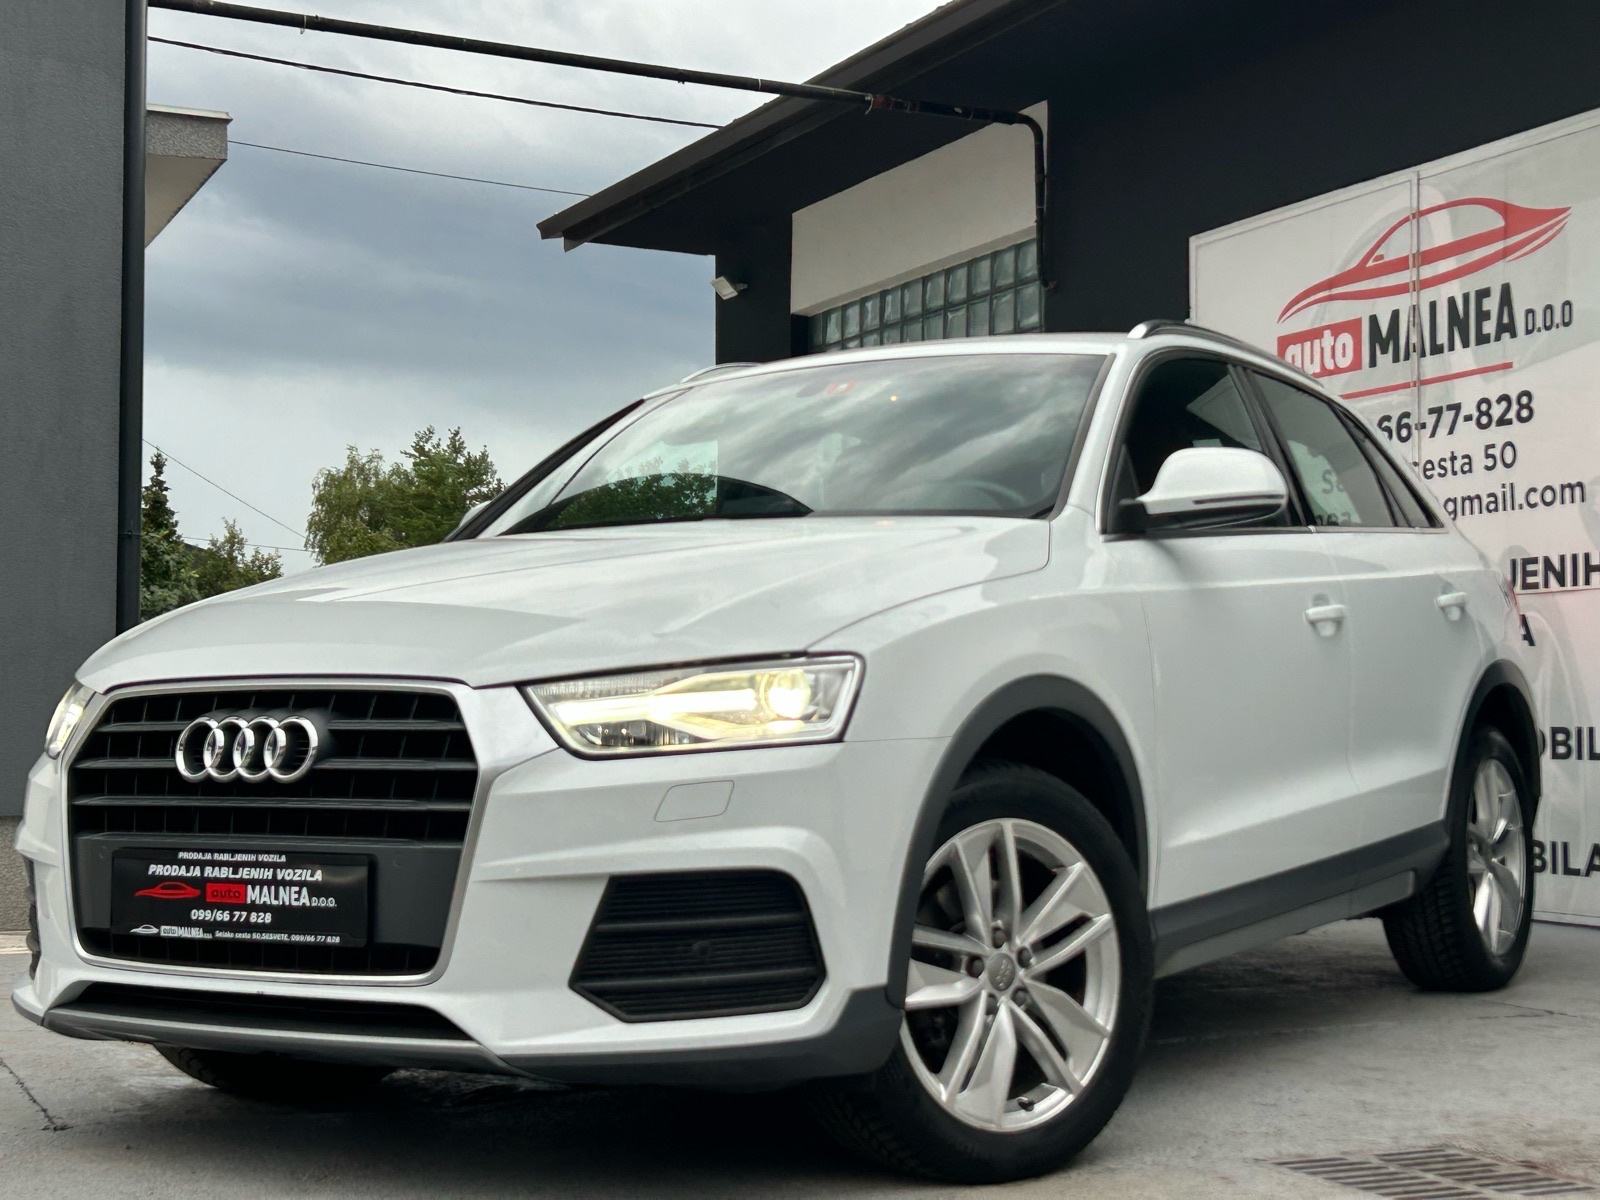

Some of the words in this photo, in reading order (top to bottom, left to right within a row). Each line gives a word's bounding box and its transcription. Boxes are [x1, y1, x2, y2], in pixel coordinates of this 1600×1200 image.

[1284, 330, 1354, 375] auto
[1368, 282, 1518, 369] MALNEA
[1412, 450, 1474, 480] esta
[1483, 440, 1517, 472] 50
[178, 851, 212, 861] PRODAJA
[213, 853, 257, 862] RABLJENIH
[258, 854, 287, 862] VOZILA
[148, 864, 201, 877] PRODAJA
[204, 866, 273, 880] RABLJENIH
[276, 868, 323, 881] VOZILA
[211, 888, 241, 899] auto
[246, 884, 310, 906] MALNEA
[190, 909, 230, 922] 099/66
[231, 911, 248, 922] 77
[249, 912, 272, 924] 828
